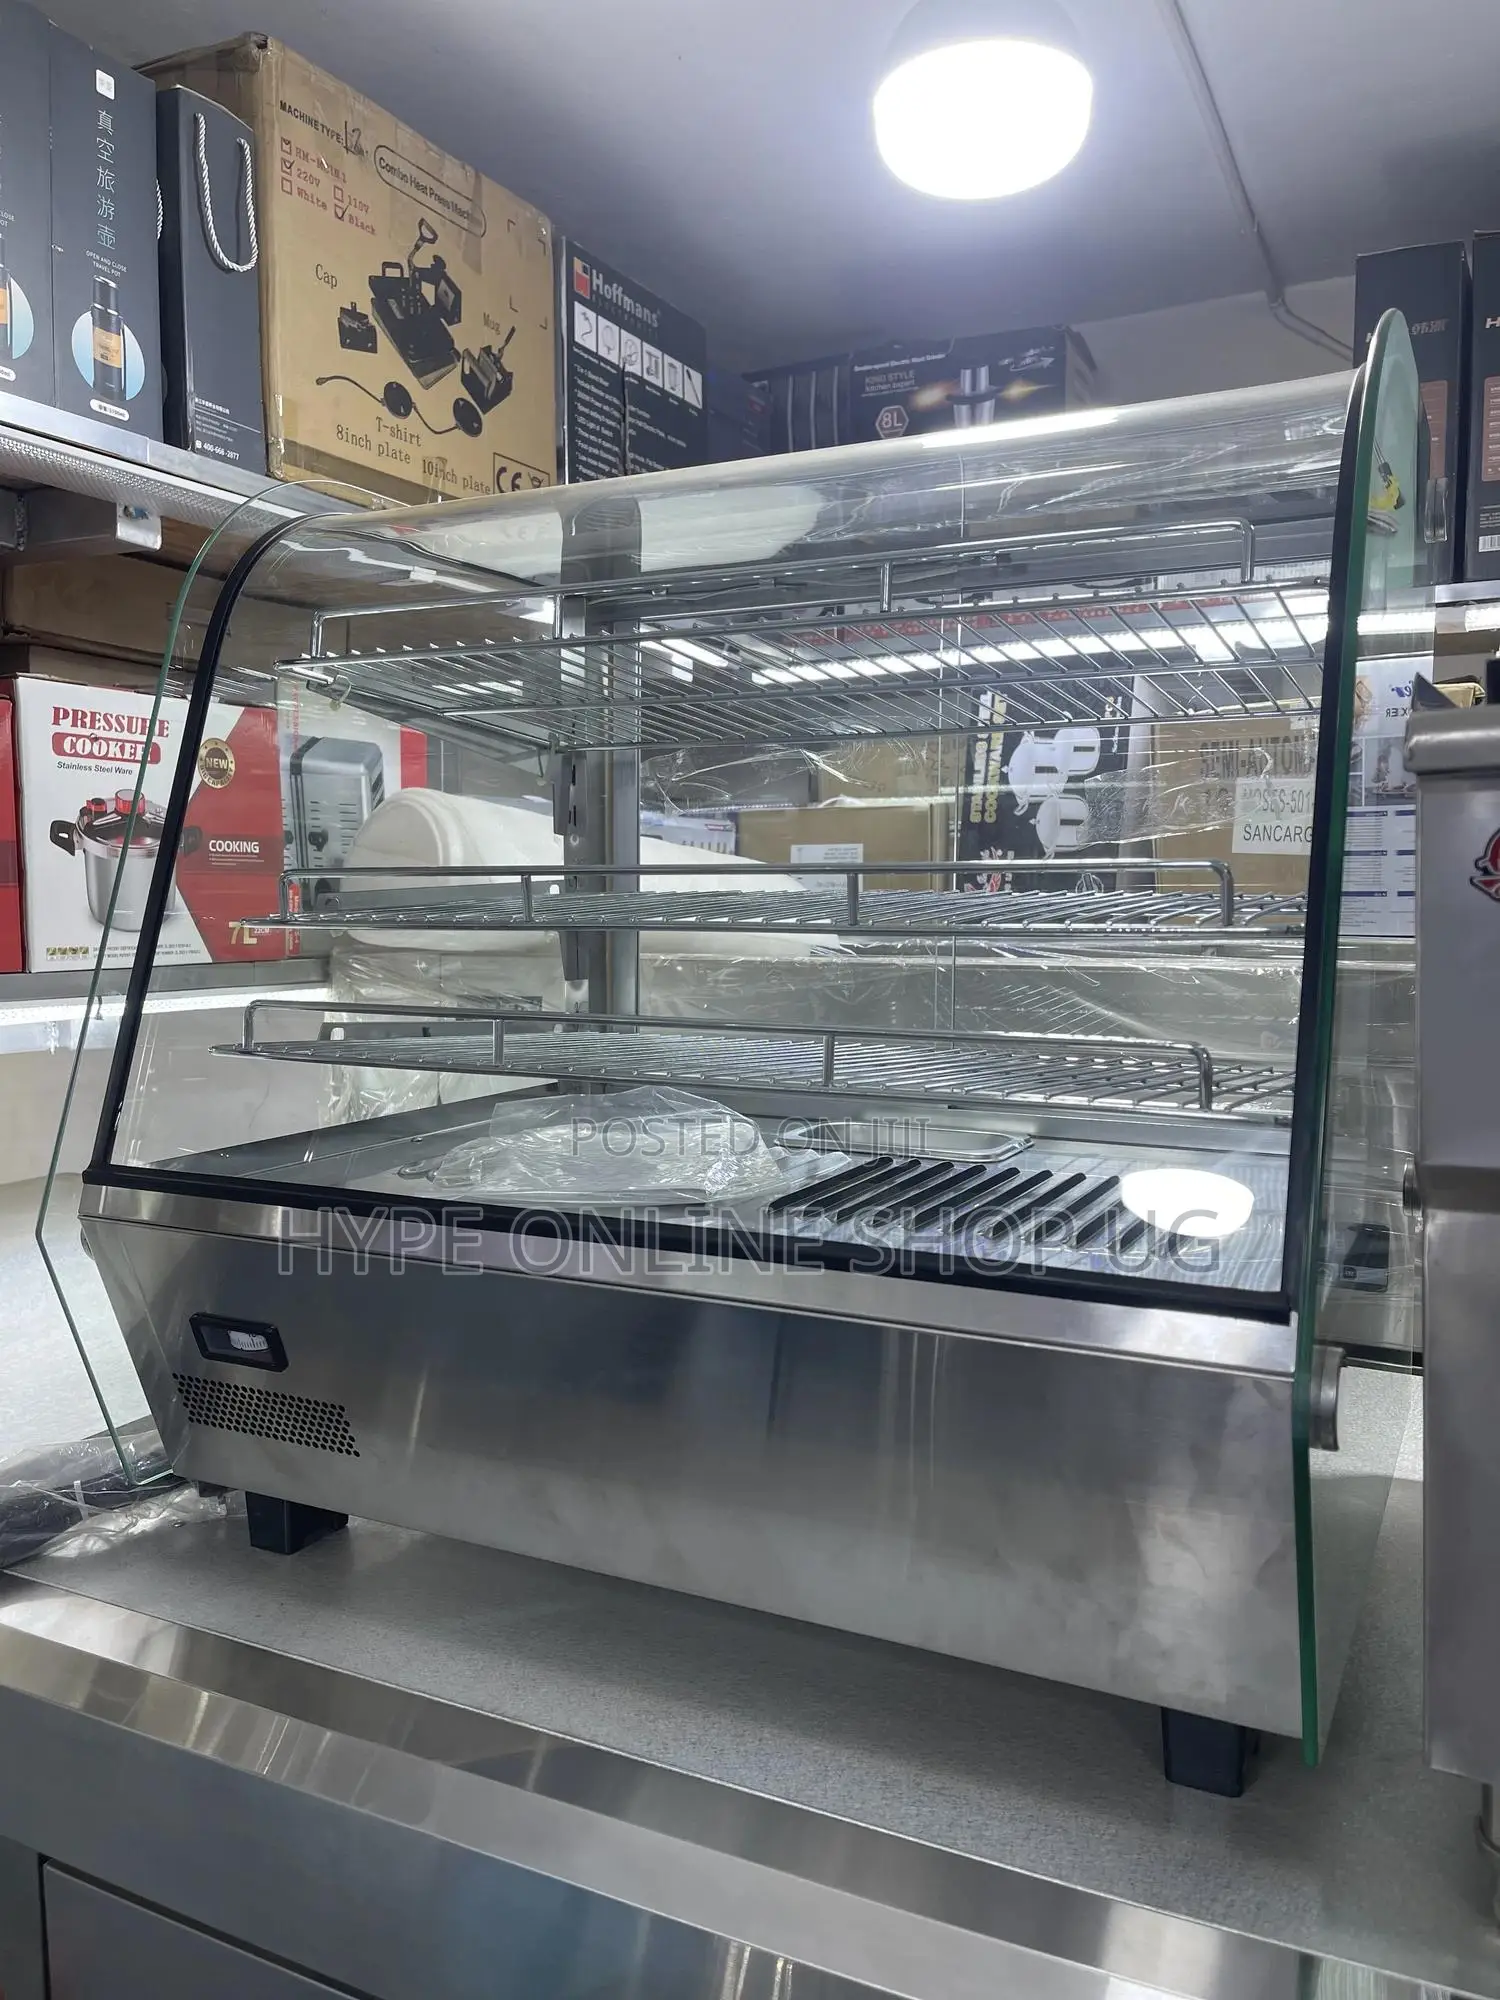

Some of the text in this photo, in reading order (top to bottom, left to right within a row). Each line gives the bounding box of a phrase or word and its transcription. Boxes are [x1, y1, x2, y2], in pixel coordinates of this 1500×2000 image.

[96, 110, 117, 250] 真空旅游壶
[379, 156, 408, 184] Combo
[410, 175, 428, 197] Heat
[297, 186, 327, 211] White
[85, 250, 100, 261] OPEN
[315, 263, 338, 288] Cap
[591, 268, 659, 329] Hoffmans
[483, 311, 501, 335] Mug
[376, 416, 422, 447] T-shirt
[882, 411, 903, 428] 8L
[336, 424, 411, 464] 8inch plate
[422, 459, 491, 495] 10inch plate
[57, 761, 133, 775] Stainless Steel Ware
[205, 757, 229, 770] NEW
[209, 840, 259, 853] COOKING
[229, 921, 258, 945] 7L
